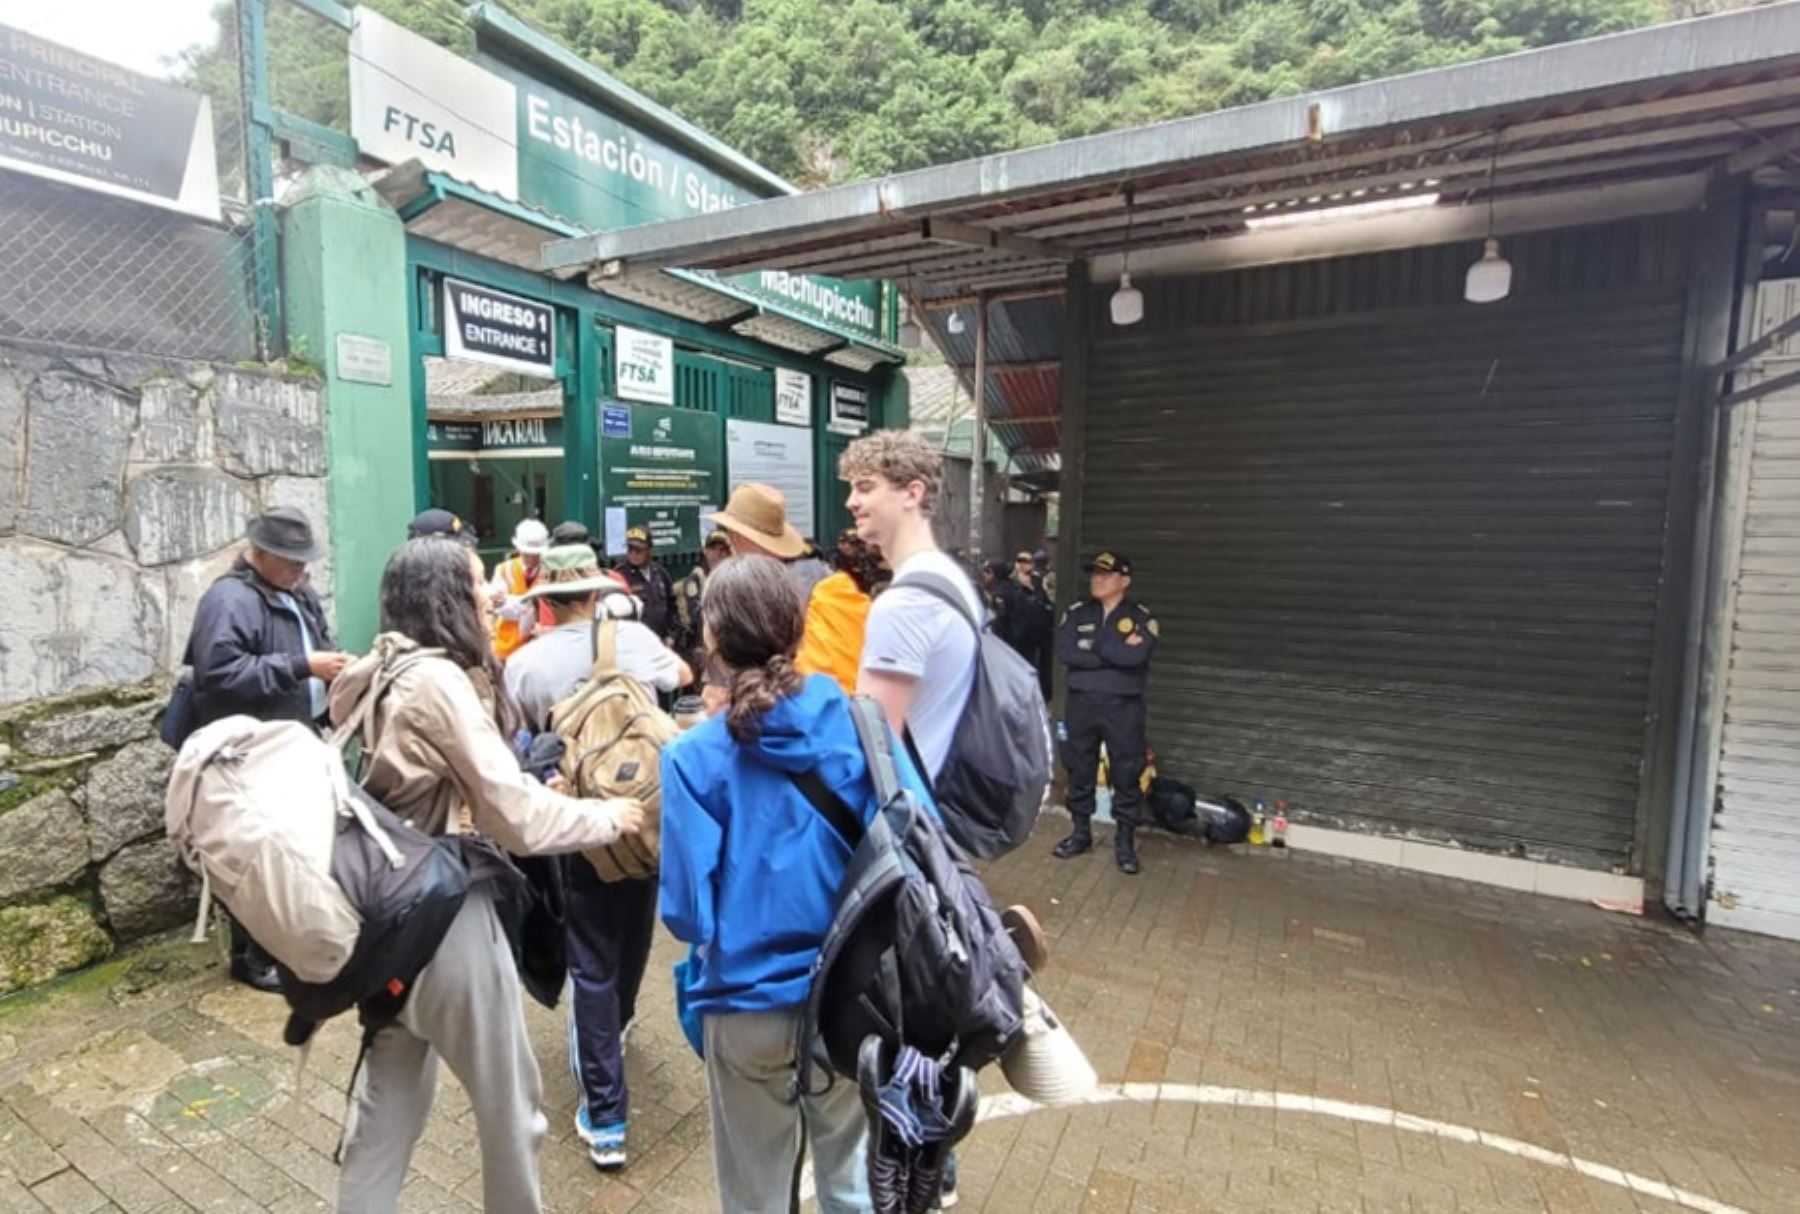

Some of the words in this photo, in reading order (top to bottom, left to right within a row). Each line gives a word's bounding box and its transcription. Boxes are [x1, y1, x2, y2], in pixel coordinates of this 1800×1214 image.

[10, 33, 144, 96] PRINCIPAL
[0, 116, 113, 161] UPICCHU
[38, 103, 122, 141] STATION
[384, 105, 457, 158] FTSA
[527, 93, 663, 190] Estación
[460, 292, 536, 330] INGRESO
[538, 313, 547, 334] 1
[760, 270, 875, 330] Machupicchu
[464, 323, 538, 355] ENTRANCE
[540, 341, 547, 356] 1
[619, 360, 656, 384] FTSA
